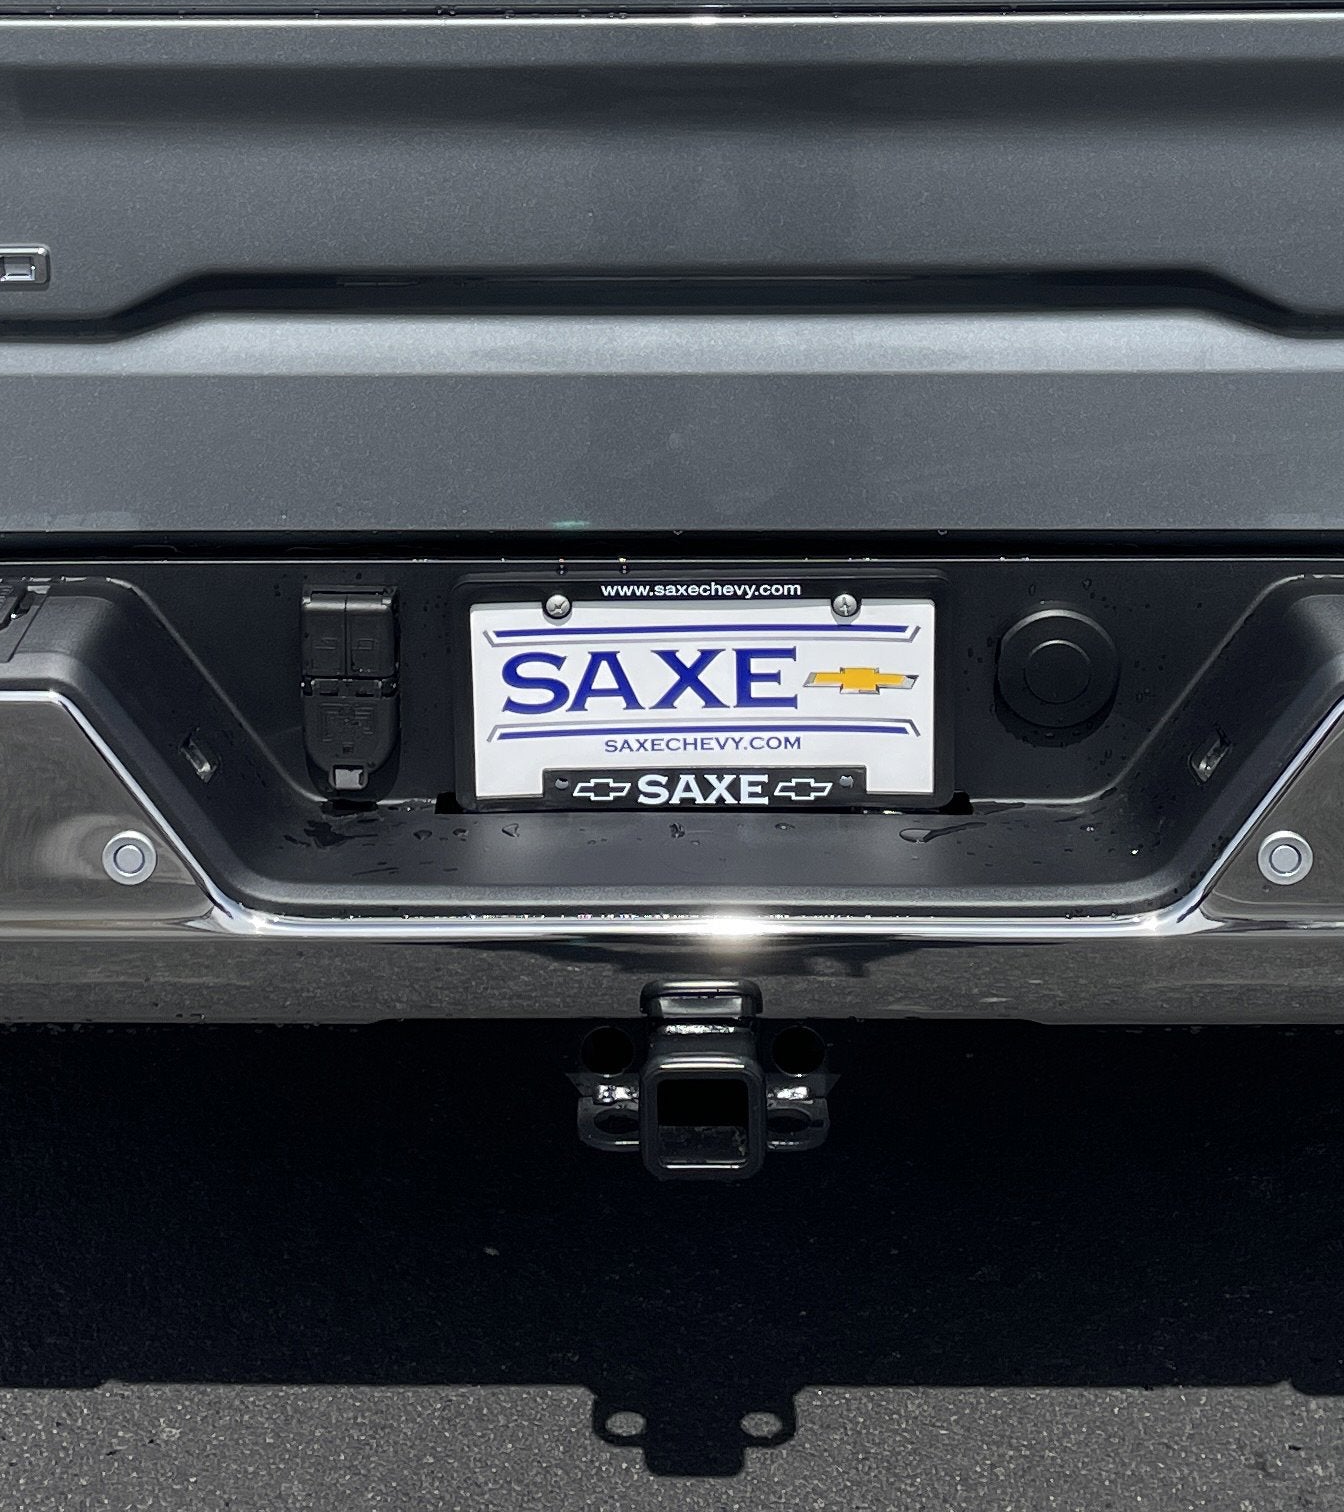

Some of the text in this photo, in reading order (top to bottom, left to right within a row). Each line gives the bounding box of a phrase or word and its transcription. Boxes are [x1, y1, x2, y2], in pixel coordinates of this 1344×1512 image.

[600, 582, 801, 599] www.saxechevy.com
[501, 645, 799, 715] SAXE
[604, 736, 801, 754] SAXECHEVY.COM
[637, 774, 769, 806] SAXE
